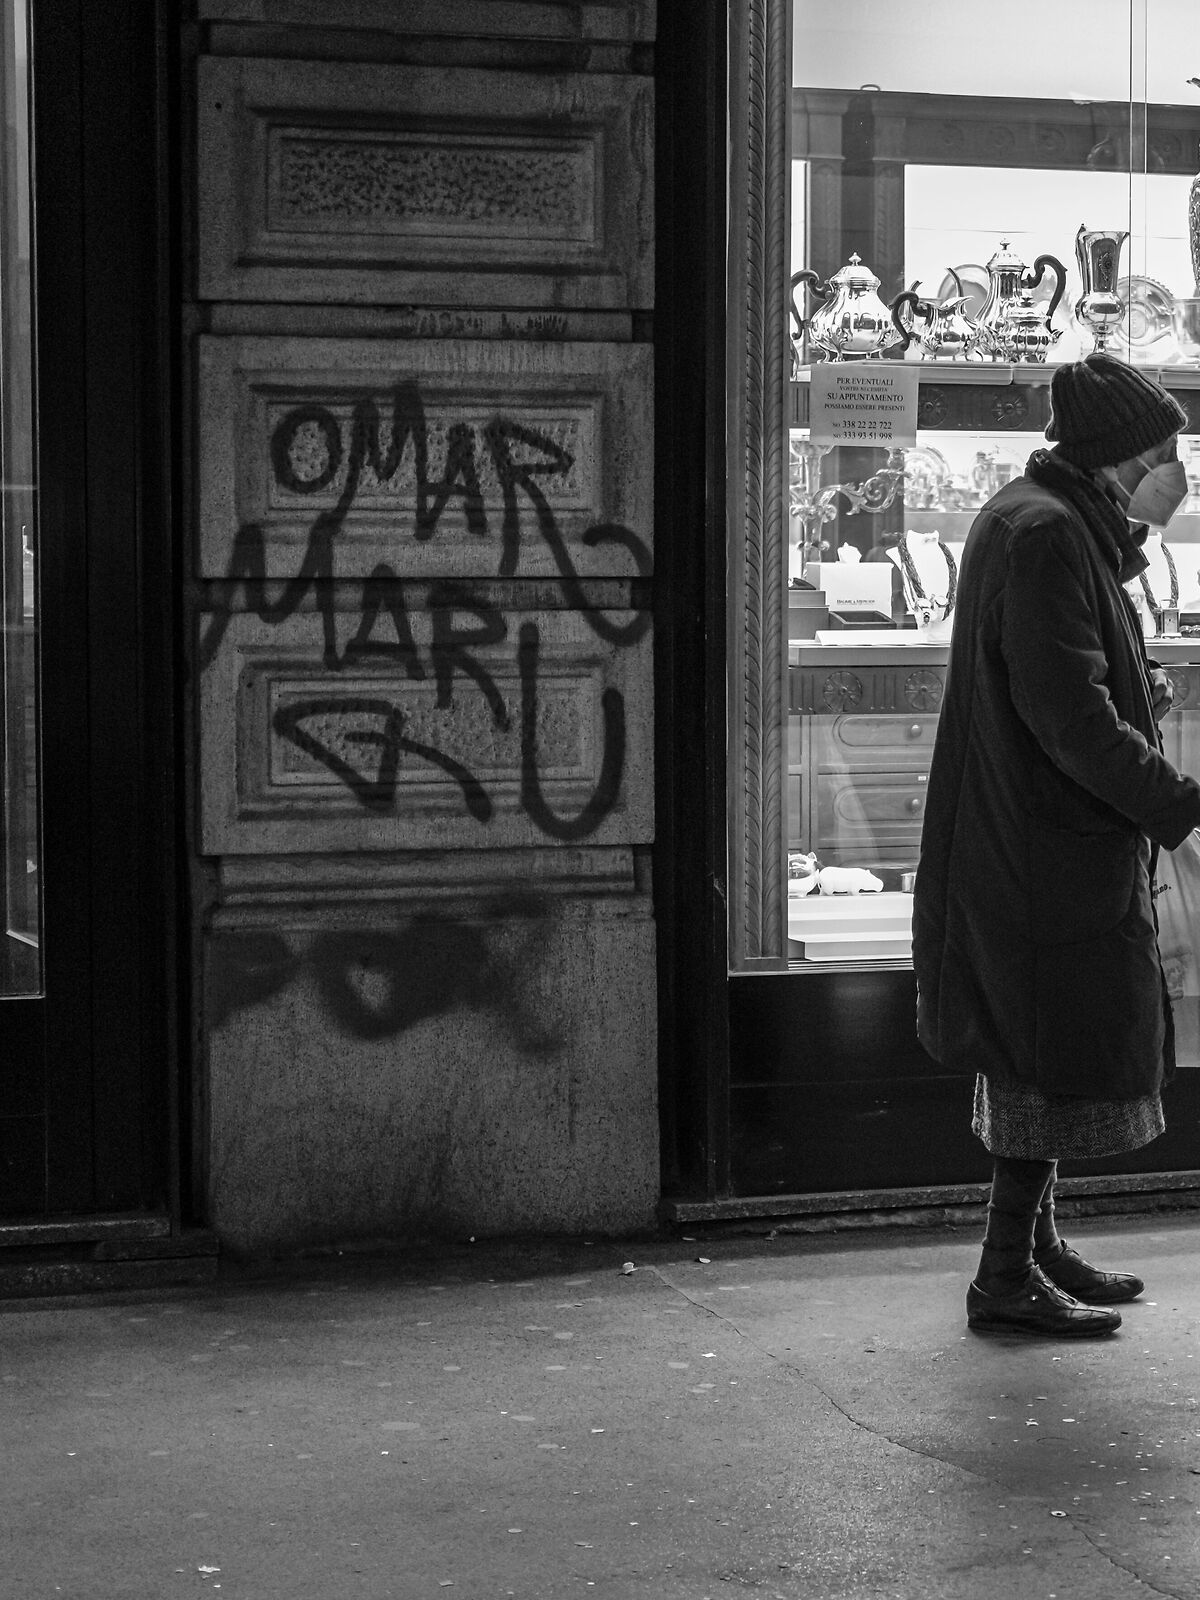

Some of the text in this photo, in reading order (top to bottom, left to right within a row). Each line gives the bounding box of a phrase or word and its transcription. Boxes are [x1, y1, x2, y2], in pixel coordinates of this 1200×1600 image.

[836, 377, 894, 386] PER EVENTUALI
[840, 393, 904, 402] APPUNTAMENTO
[857, 421, 866, 429] 22
[868, 421, 877, 429] 22
[879, 421, 892, 429] 722
[879, 432, 893, 440] 998
